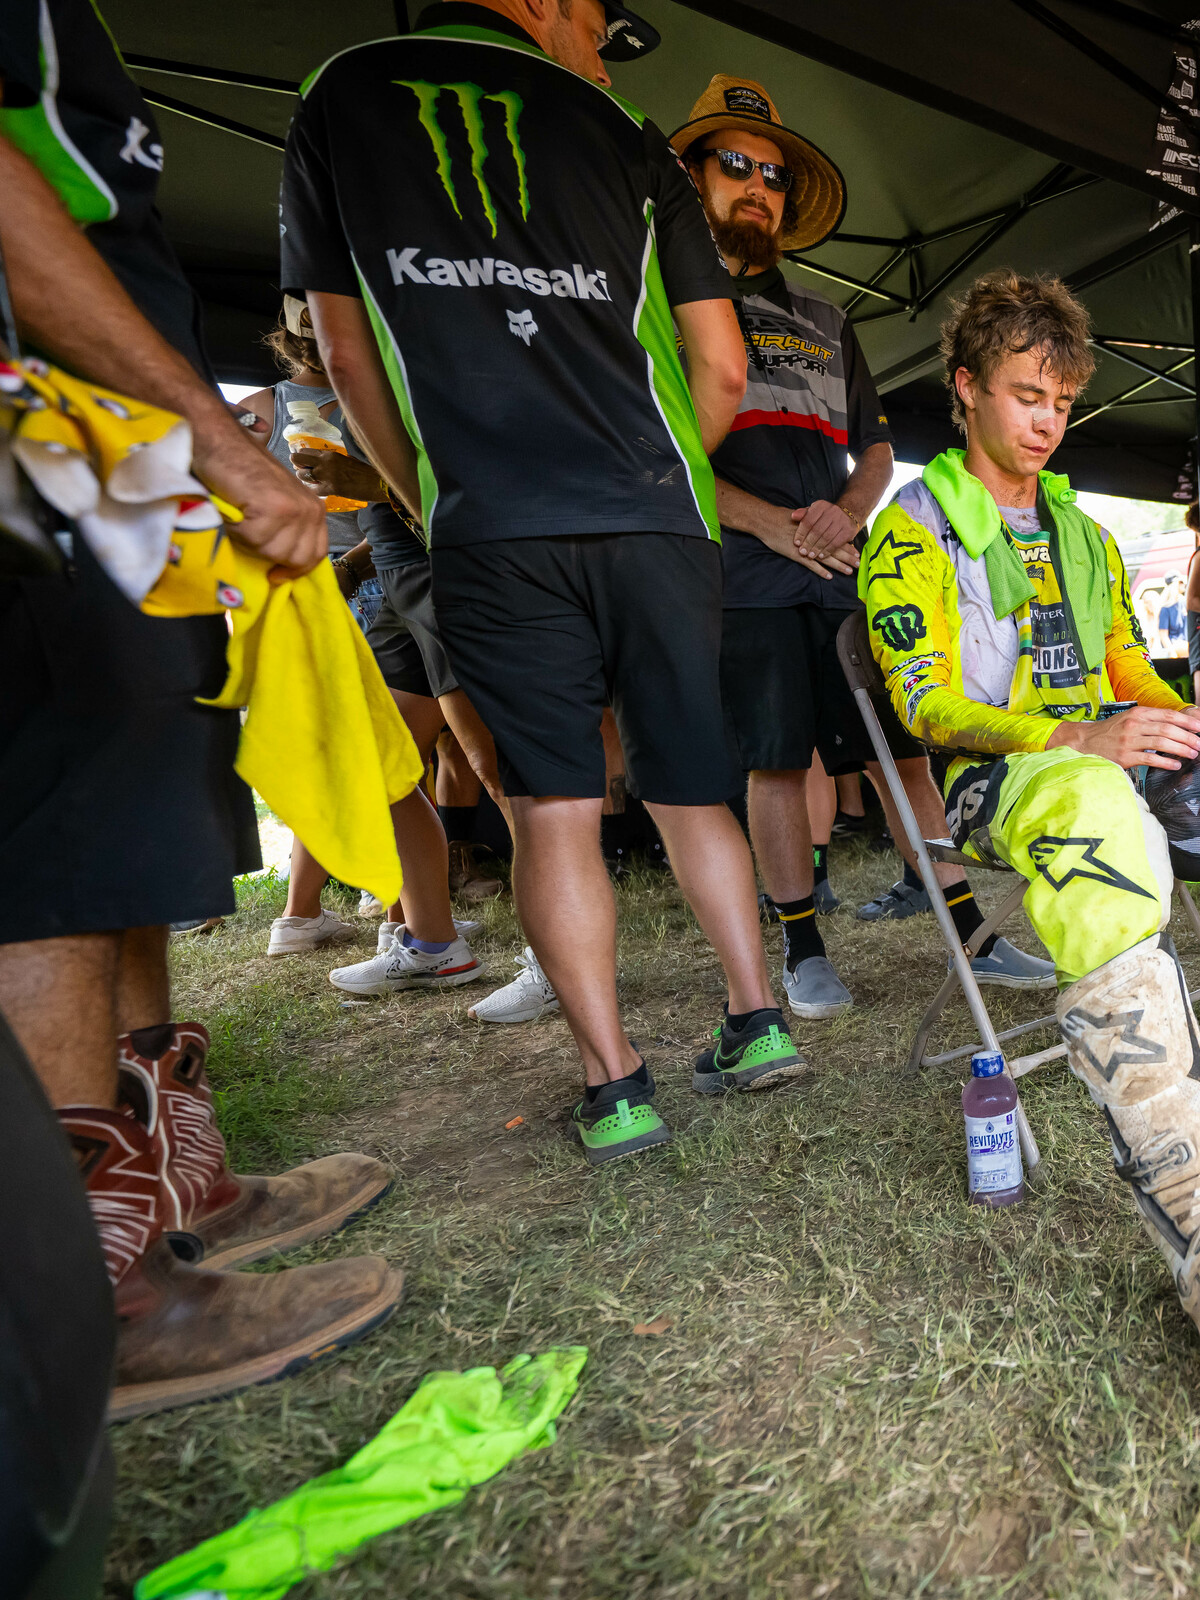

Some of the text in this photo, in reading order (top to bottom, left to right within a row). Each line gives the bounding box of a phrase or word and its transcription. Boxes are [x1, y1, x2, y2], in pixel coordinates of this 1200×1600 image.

[386, 247, 613, 302] Kawasaki
[748, 353, 827, 378] SUPPORT
[969, 1129, 1014, 1148] REVITALYTE
[990, 1139, 1015, 1153] ZERO
